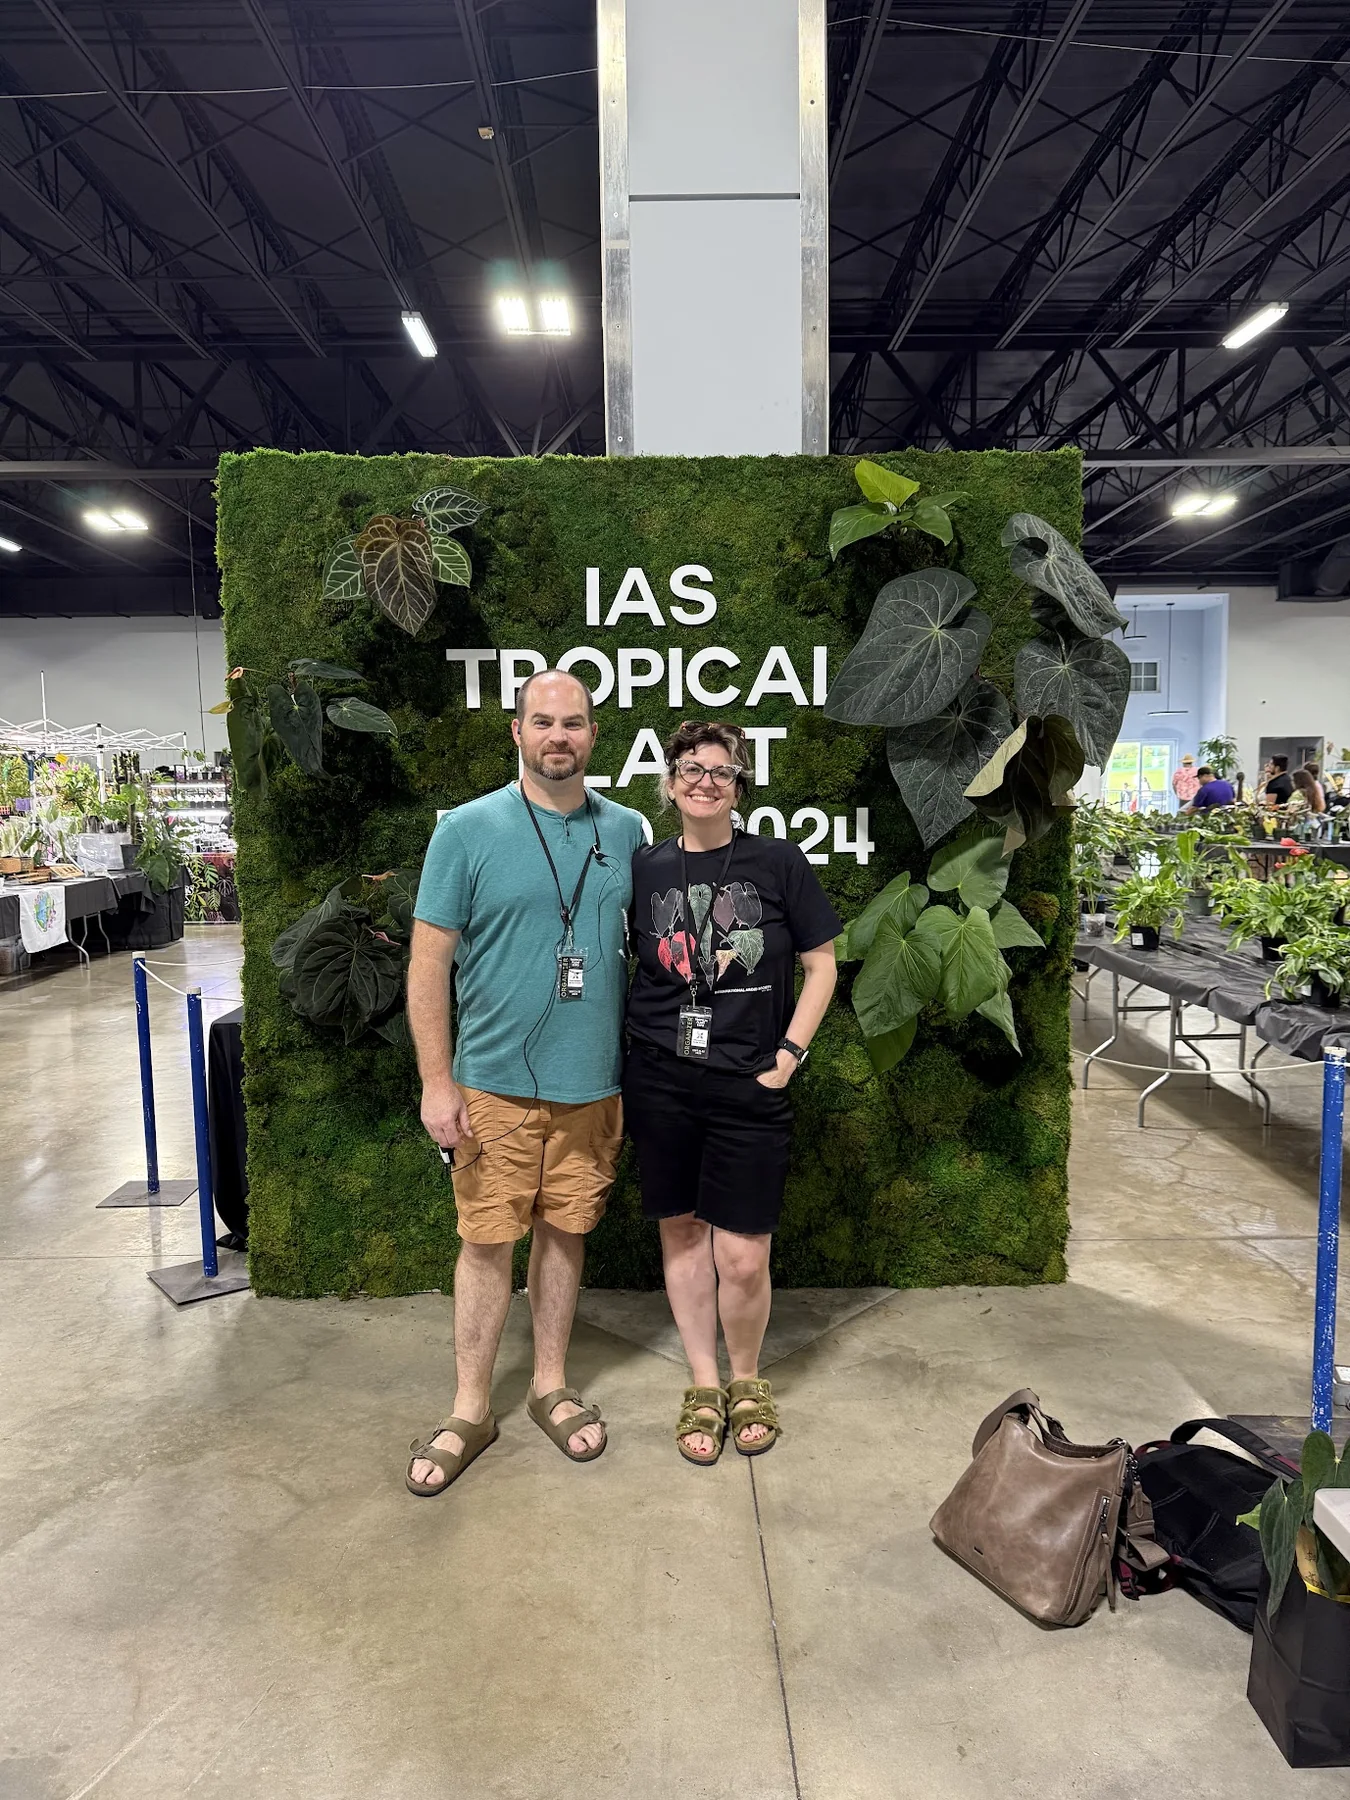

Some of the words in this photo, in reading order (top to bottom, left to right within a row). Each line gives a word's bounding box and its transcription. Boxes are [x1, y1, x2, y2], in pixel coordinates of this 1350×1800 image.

[586, 565, 718, 626] IAS
[730, 806, 875, 865] 024
[561, 957, 569, 997] ORGANIZER
[684, 1017, 694, 1055] ORGANIZER
